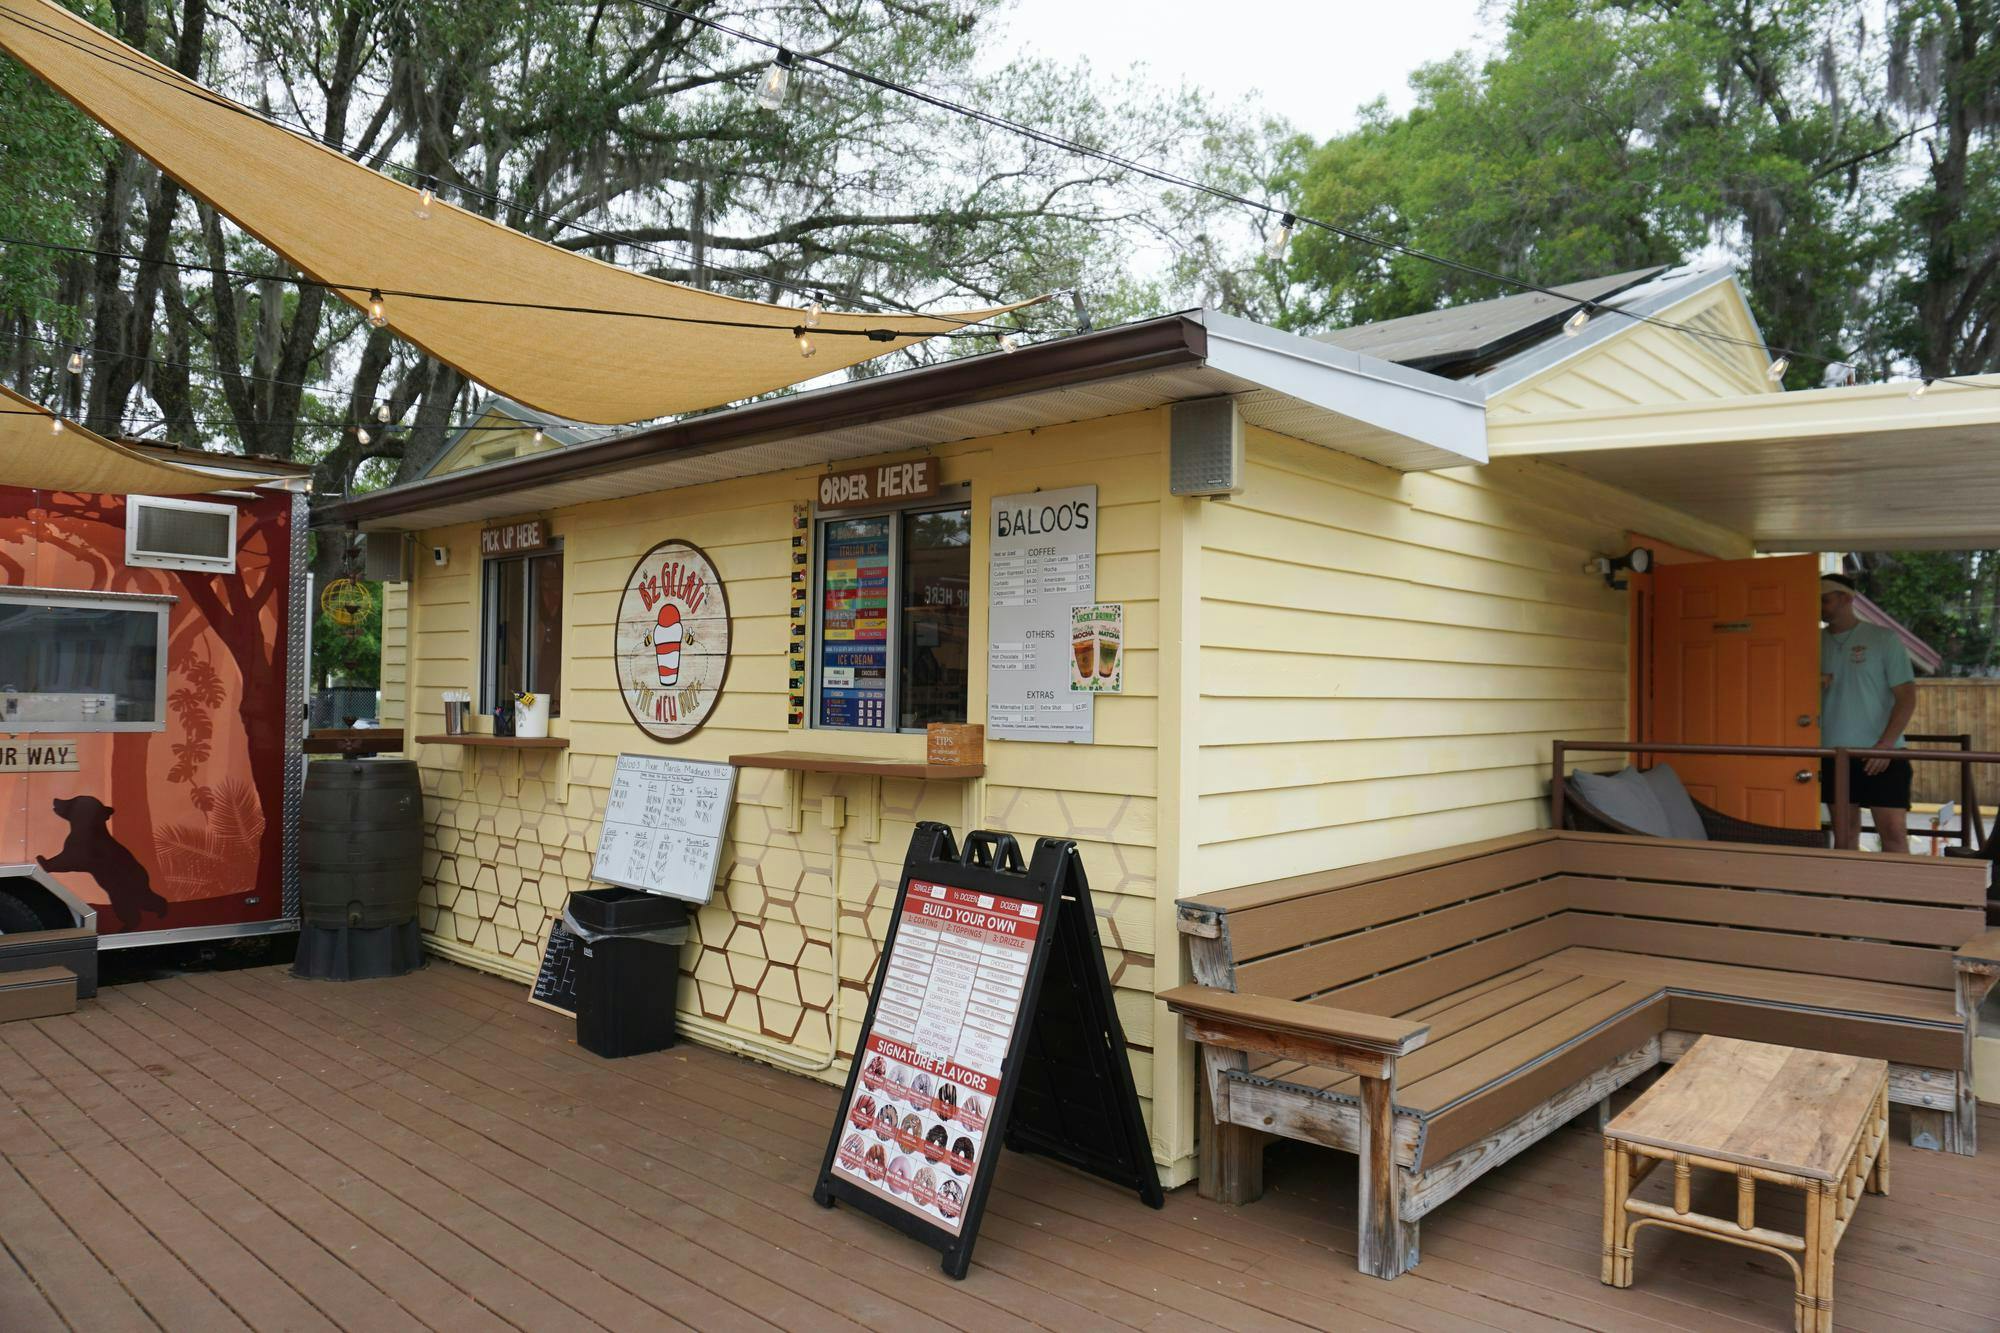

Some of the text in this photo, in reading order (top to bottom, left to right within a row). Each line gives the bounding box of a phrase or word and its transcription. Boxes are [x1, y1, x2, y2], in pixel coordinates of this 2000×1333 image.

[820, 462, 928, 504] ORDER HERE
[998, 501, 1089, 537] BALOO'S
[482, 522, 540, 552] PICK UP HERE
[841, 544, 878, 557] ITALIAN ICE
[1028, 547, 1056, 557] COFFEE
[662, 562, 704, 614] GELATI
[1076, 612, 1116, 622] LUCKY DRINKS
[1026, 630, 1054, 638] OTHERS
[1073, 630, 1094, 640] MOCHA
[1098, 630, 1120, 639] MATCHA
[838, 654, 874, 664] ICE CREAM
[1027, 690, 1054, 699] EXTRAS
[656, 696, 678, 722] NEW
[935, 736, 953, 746] TIPS
[28, 747, 68, 765] WAY
[664, 762, 681, 772] March
[684, 764, 710, 777] Madness
[913, 916, 938, 928] COATING
[922, 903, 1016, 933] BUILD YOUR OWN
[952, 926, 982, 938] TOPPINGS
[999, 936, 1025, 947] DRIZZLE
[935, 958, 976, 973] CHOCOLATE SPRINKLES
[990, 959, 1013, 969] CHOCOLATE
[936, 968, 956, 977] POWDERED
[934, 976, 954, 986] CINNAMON
[985, 983, 1007, 993] BLUEBERRY
[941, 1007, 960, 1016] CRACKERS
[990, 1011, 1005, 1020] BUTTER
[917, 1037, 950, 1052] CHOCOLATE CHIPS
[876, 1040, 934, 1070] SIGNATURE
[935, 1062, 987, 1089] FLAVORS
